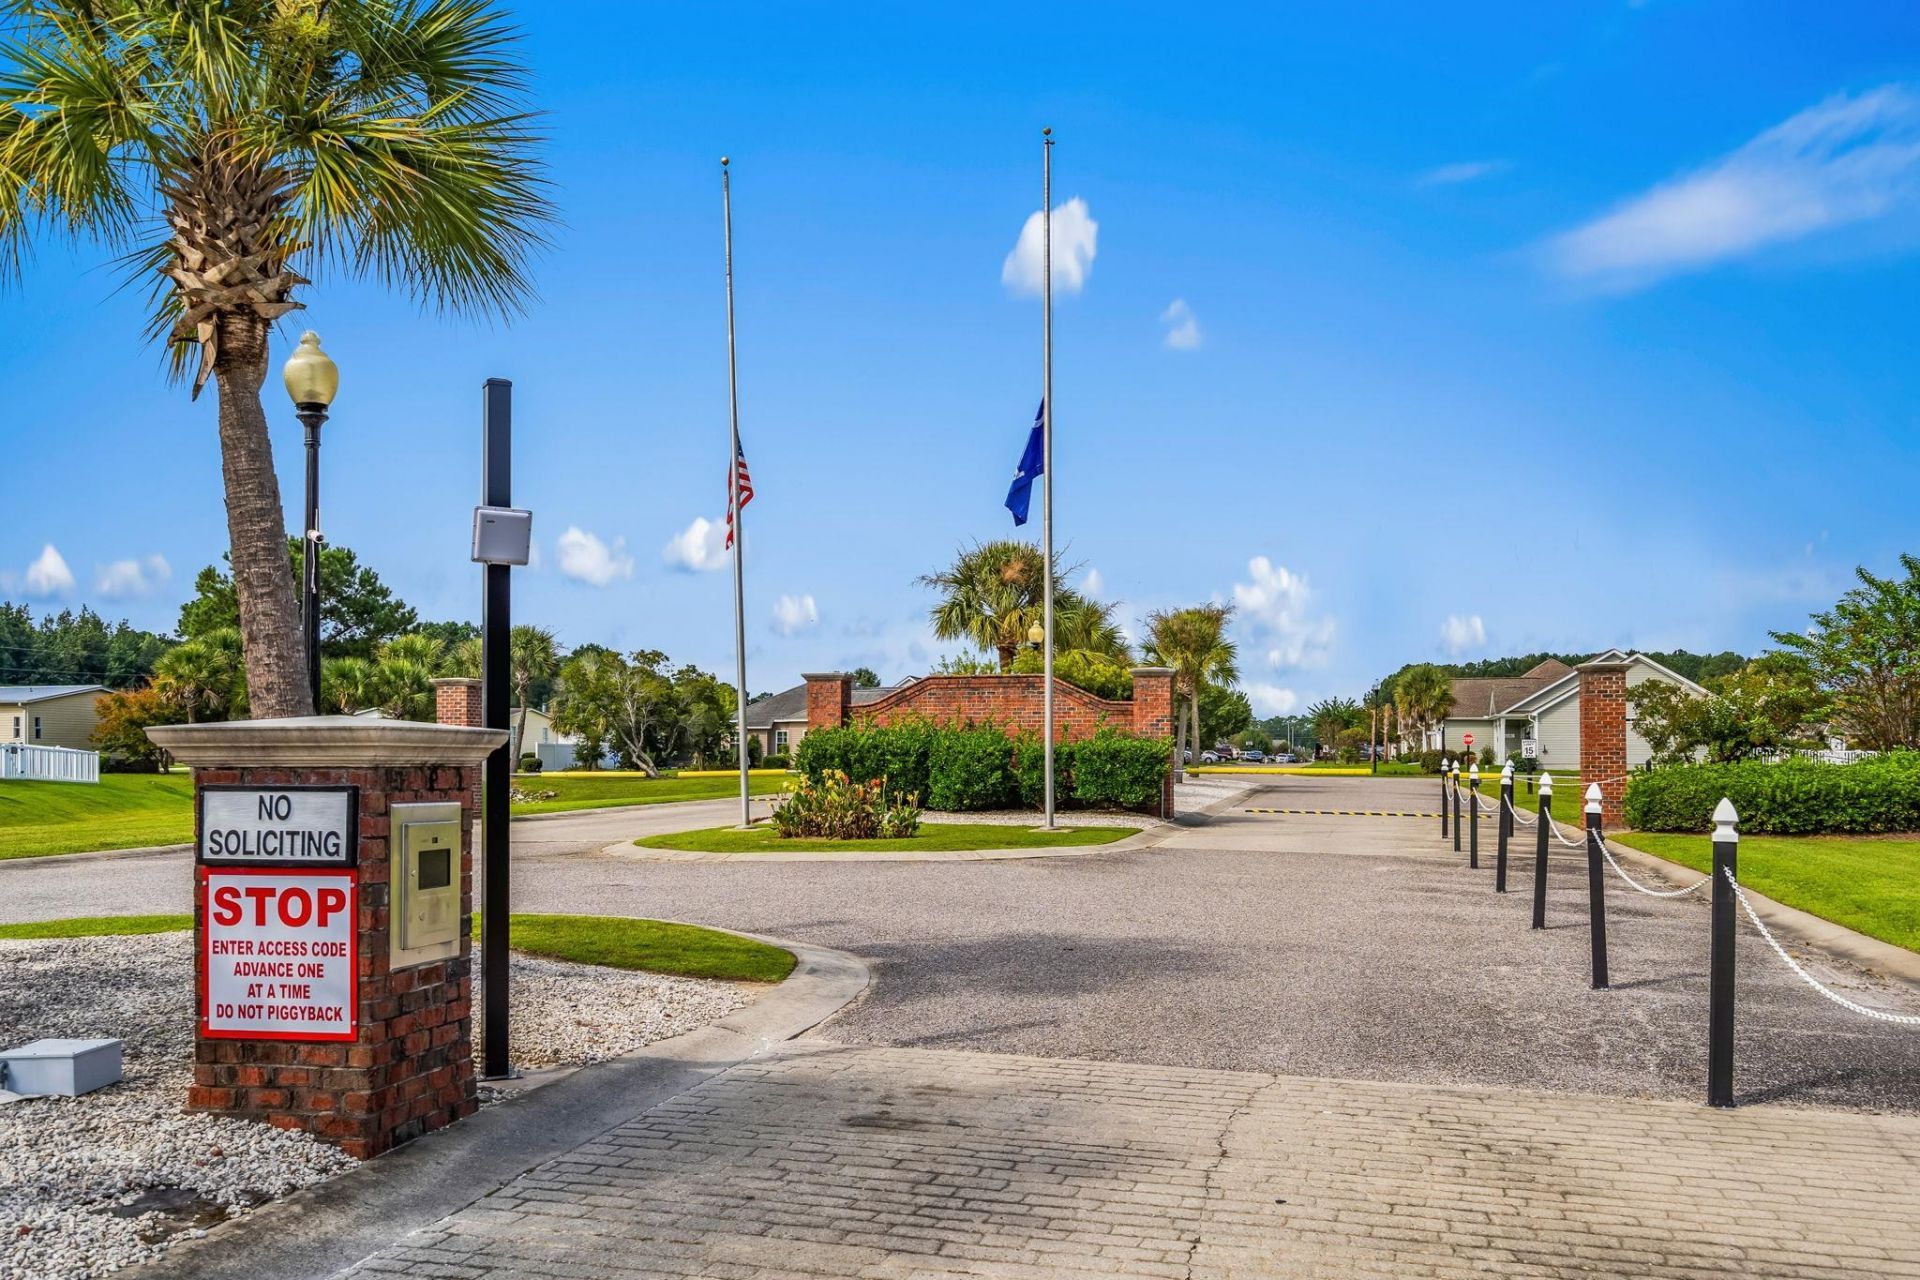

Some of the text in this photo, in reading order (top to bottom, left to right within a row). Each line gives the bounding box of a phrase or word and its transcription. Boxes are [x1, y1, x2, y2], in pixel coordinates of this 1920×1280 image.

[1525, 747, 1534, 755] 15
[258, 794, 292, 821] NO
[208, 829, 341, 857] SOLICITING
[213, 886, 347, 928] STOP
[212, 940, 347, 957] ENTER ACCESS CODE
[233, 962, 324, 978] ADVANCE ONE
[247, 983, 311, 999] AT A TIME
[216, 1004, 343, 1021] DO NOT PIGGYBACK
